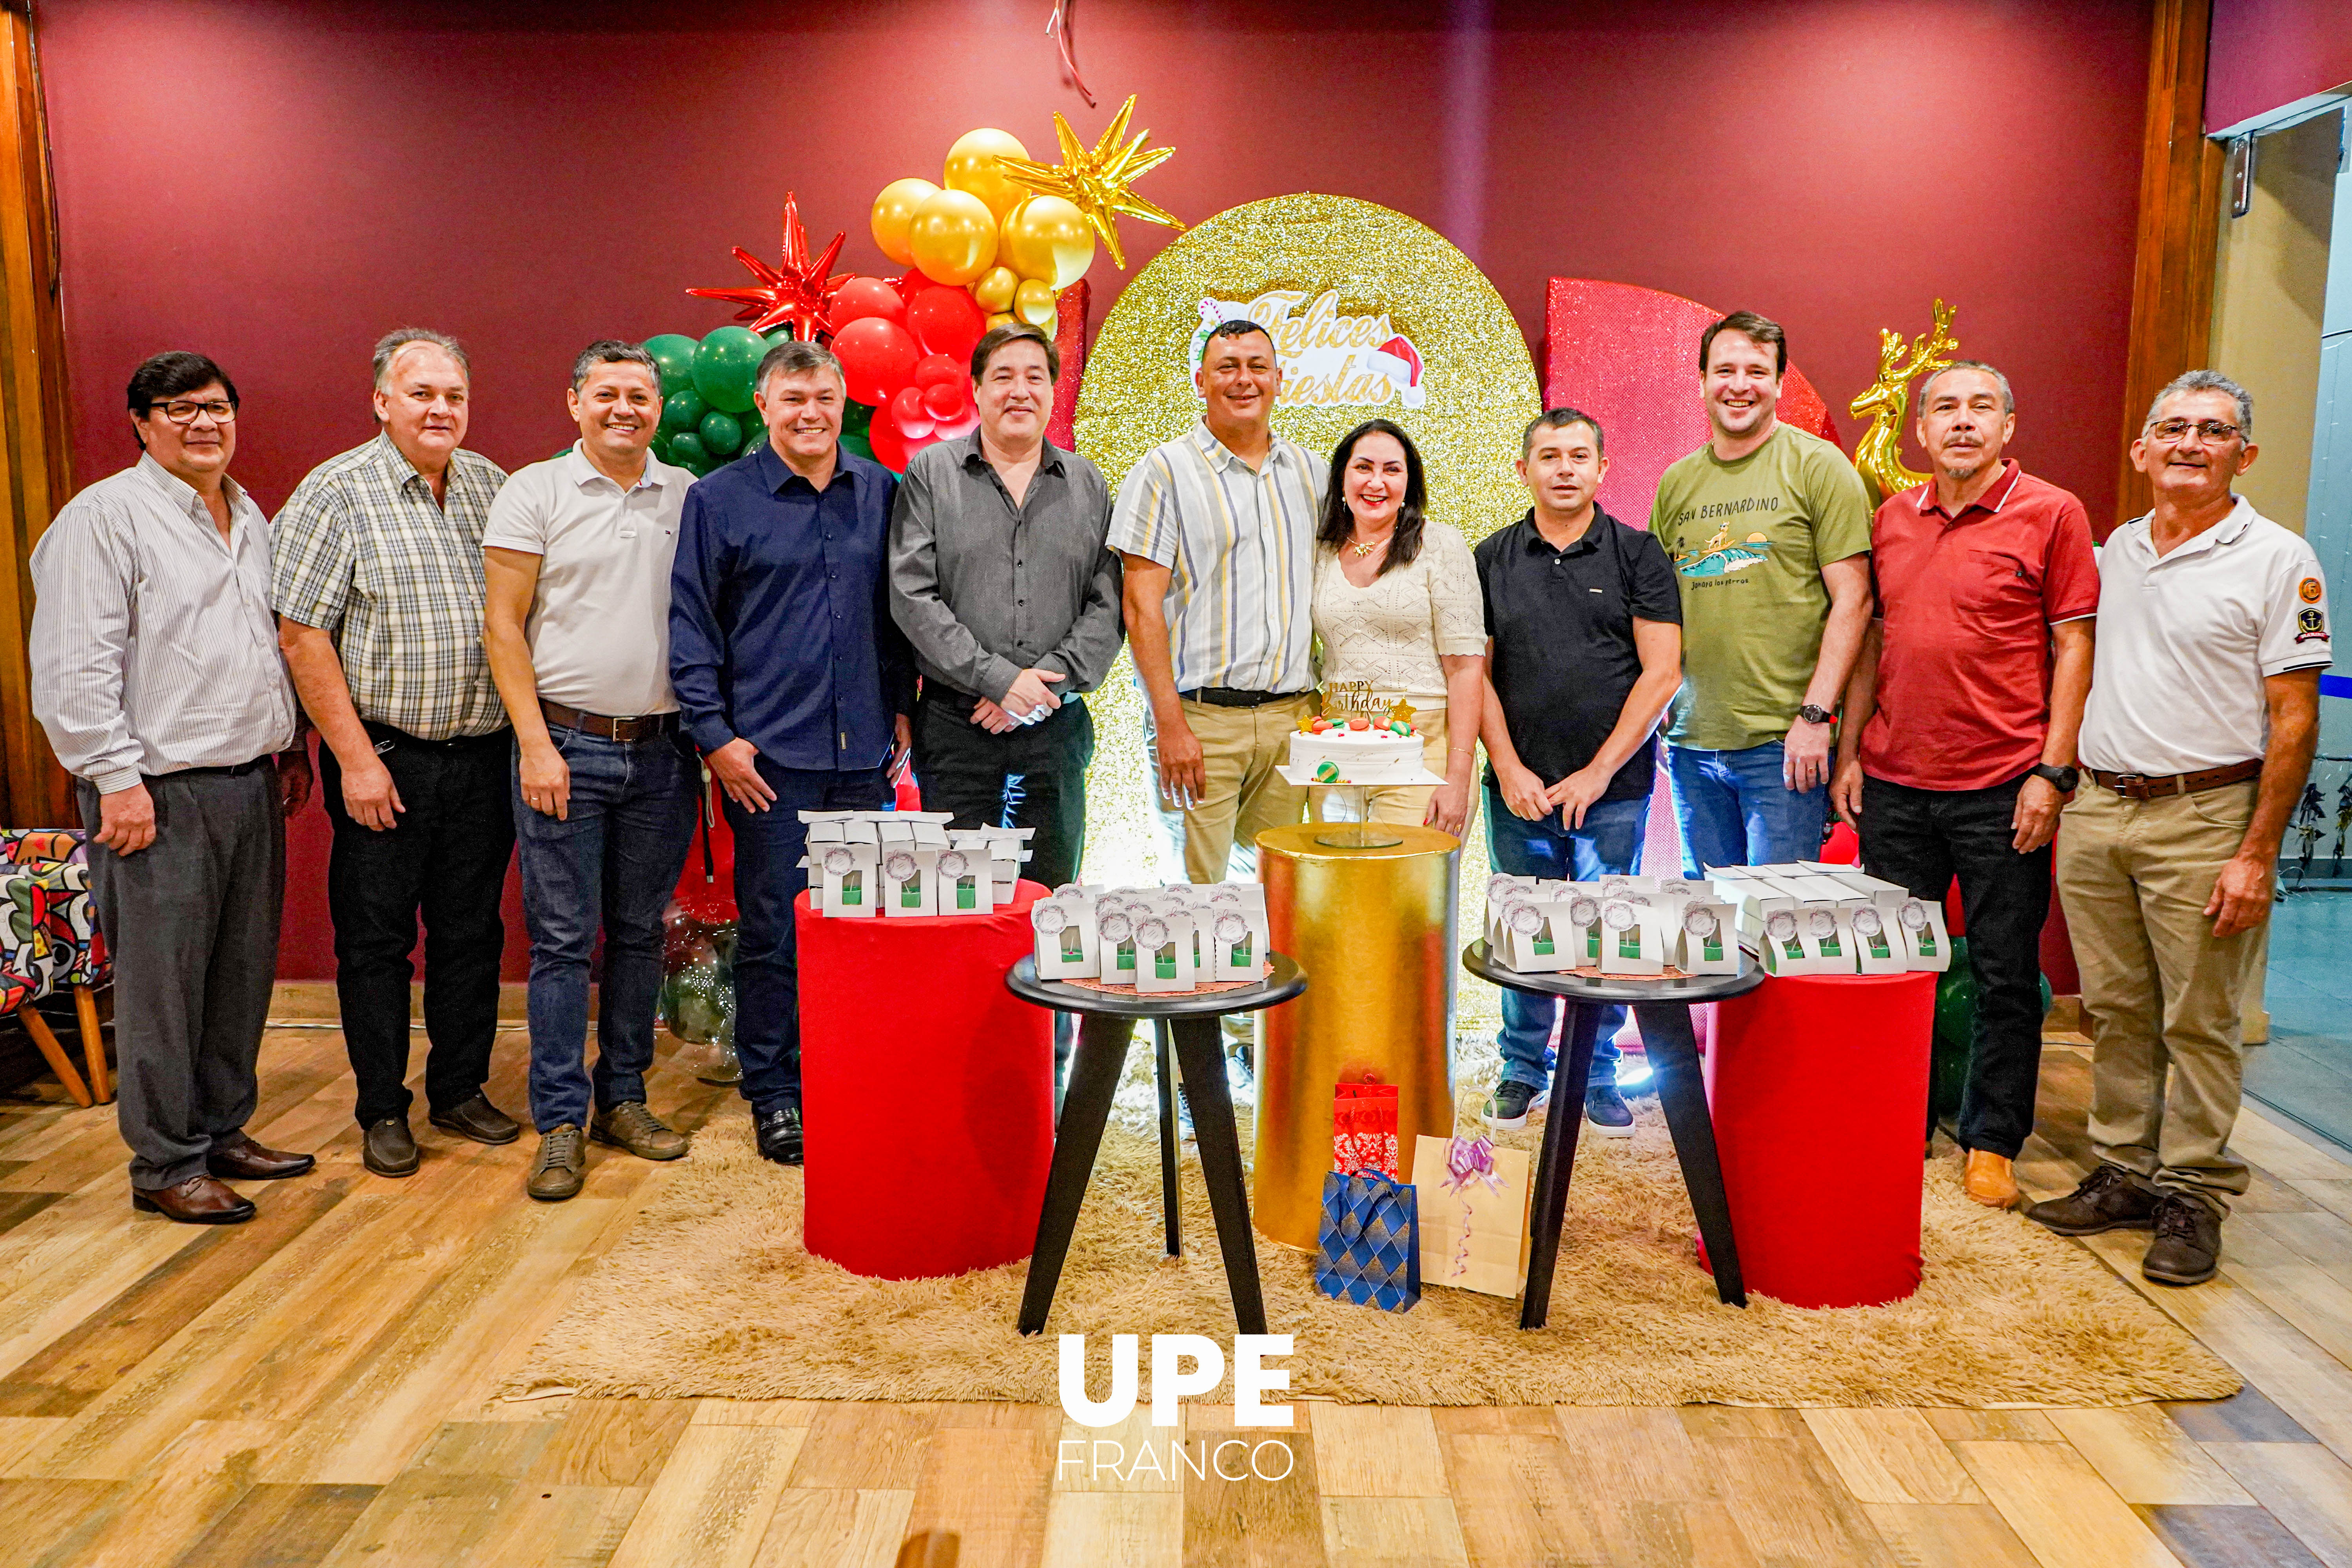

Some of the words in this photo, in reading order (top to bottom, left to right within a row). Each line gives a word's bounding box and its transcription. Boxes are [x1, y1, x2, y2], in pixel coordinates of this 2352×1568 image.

[1248, 292, 1390, 350] Felices
[1275, 349, 1392, 405] iestas
[1678, 508, 1697, 526] SAN
[1700, 497, 1778, 519] BERNARDINO
[1328, 680, 1374, 692] HAPPY
